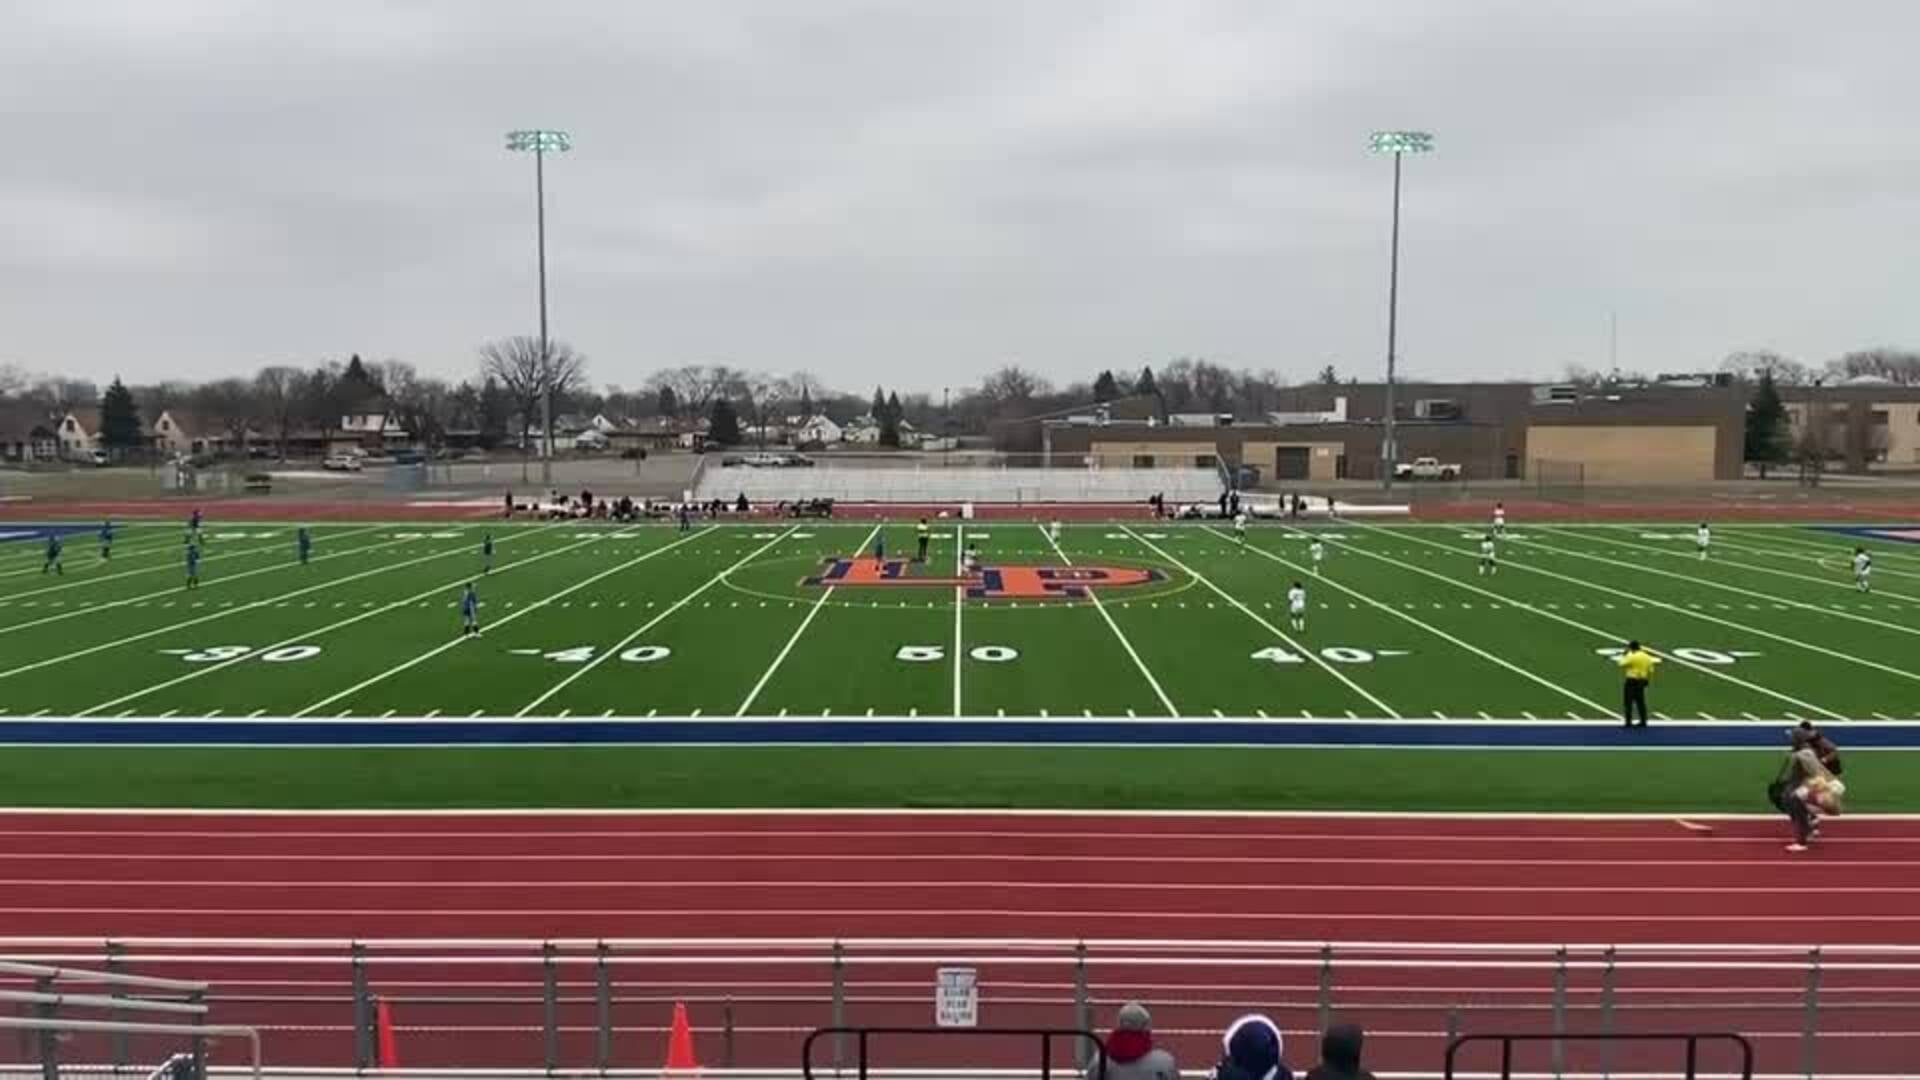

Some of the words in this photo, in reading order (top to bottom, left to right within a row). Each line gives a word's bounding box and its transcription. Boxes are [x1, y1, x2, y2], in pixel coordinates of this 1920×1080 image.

[183, 645, 321, 661] 30
[543, 646, 671, 662] 40
[895, 645, 1018, 661] 50
[1250, 647, 1374, 662] 40
